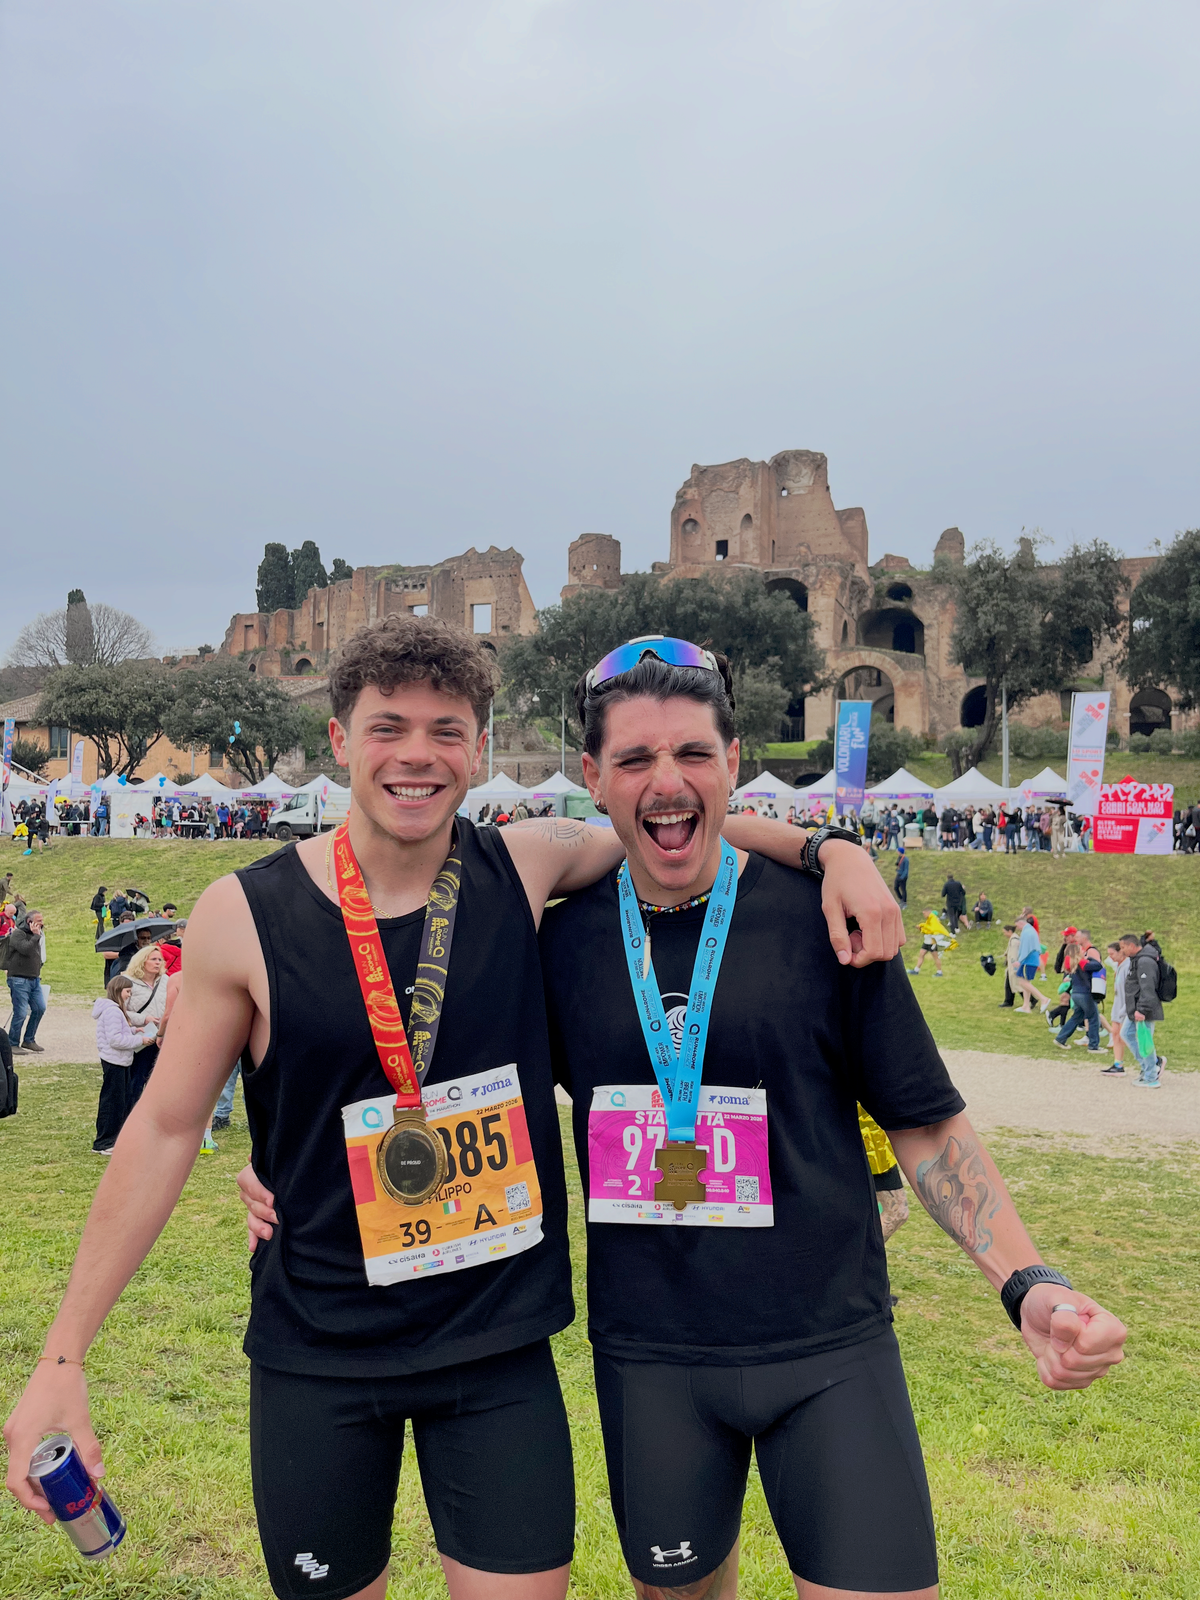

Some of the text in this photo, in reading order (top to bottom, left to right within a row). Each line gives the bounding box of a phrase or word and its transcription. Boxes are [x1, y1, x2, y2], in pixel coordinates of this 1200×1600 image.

[837, 726, 851, 772] VOLONTARI
[339, 853, 348, 869] ROME
[712, 904, 722, 927] EMPOWER
[433, 928, 442, 946] ROME
[360, 959, 369, 974] RUN
[365, 953, 375, 972] ROME
[704, 949, 715, 980] RUN4ROME
[641, 988, 651, 1020] RUN4ROME
[694, 990, 703, 1013] EMOTION
[415, 1041, 424, 1061] ROME
[422, 1041, 430, 1055] RUN
[657, 1041, 669, 1067] EMPOWER
[690, 1037, 699, 1070] RUN4ROME
[394, 1065, 405, 1084] ROME
[421, 1090, 439, 1100] RUN
[681, 1081, 689, 1101] BREATH
[424, 1096, 447, 1108] ROME
[436, 1102, 461, 1112] MARATHON
[484, 1103, 504, 1113] MARZO
[505, 1099, 518, 1107] 2026
[635, 1111, 724, 1126] STATTA
[628, 1175, 642, 1195] 2
[473, 1204, 498, 1230] A
[400, 1219, 431, 1248] 39
[479, 1232, 507, 1243] HYUNDAI
[399, 1252, 426, 1263] cisalfa
[65, 1486, 94, 1514] Red
[672, 1555, 698, 1567] ARMOUR
